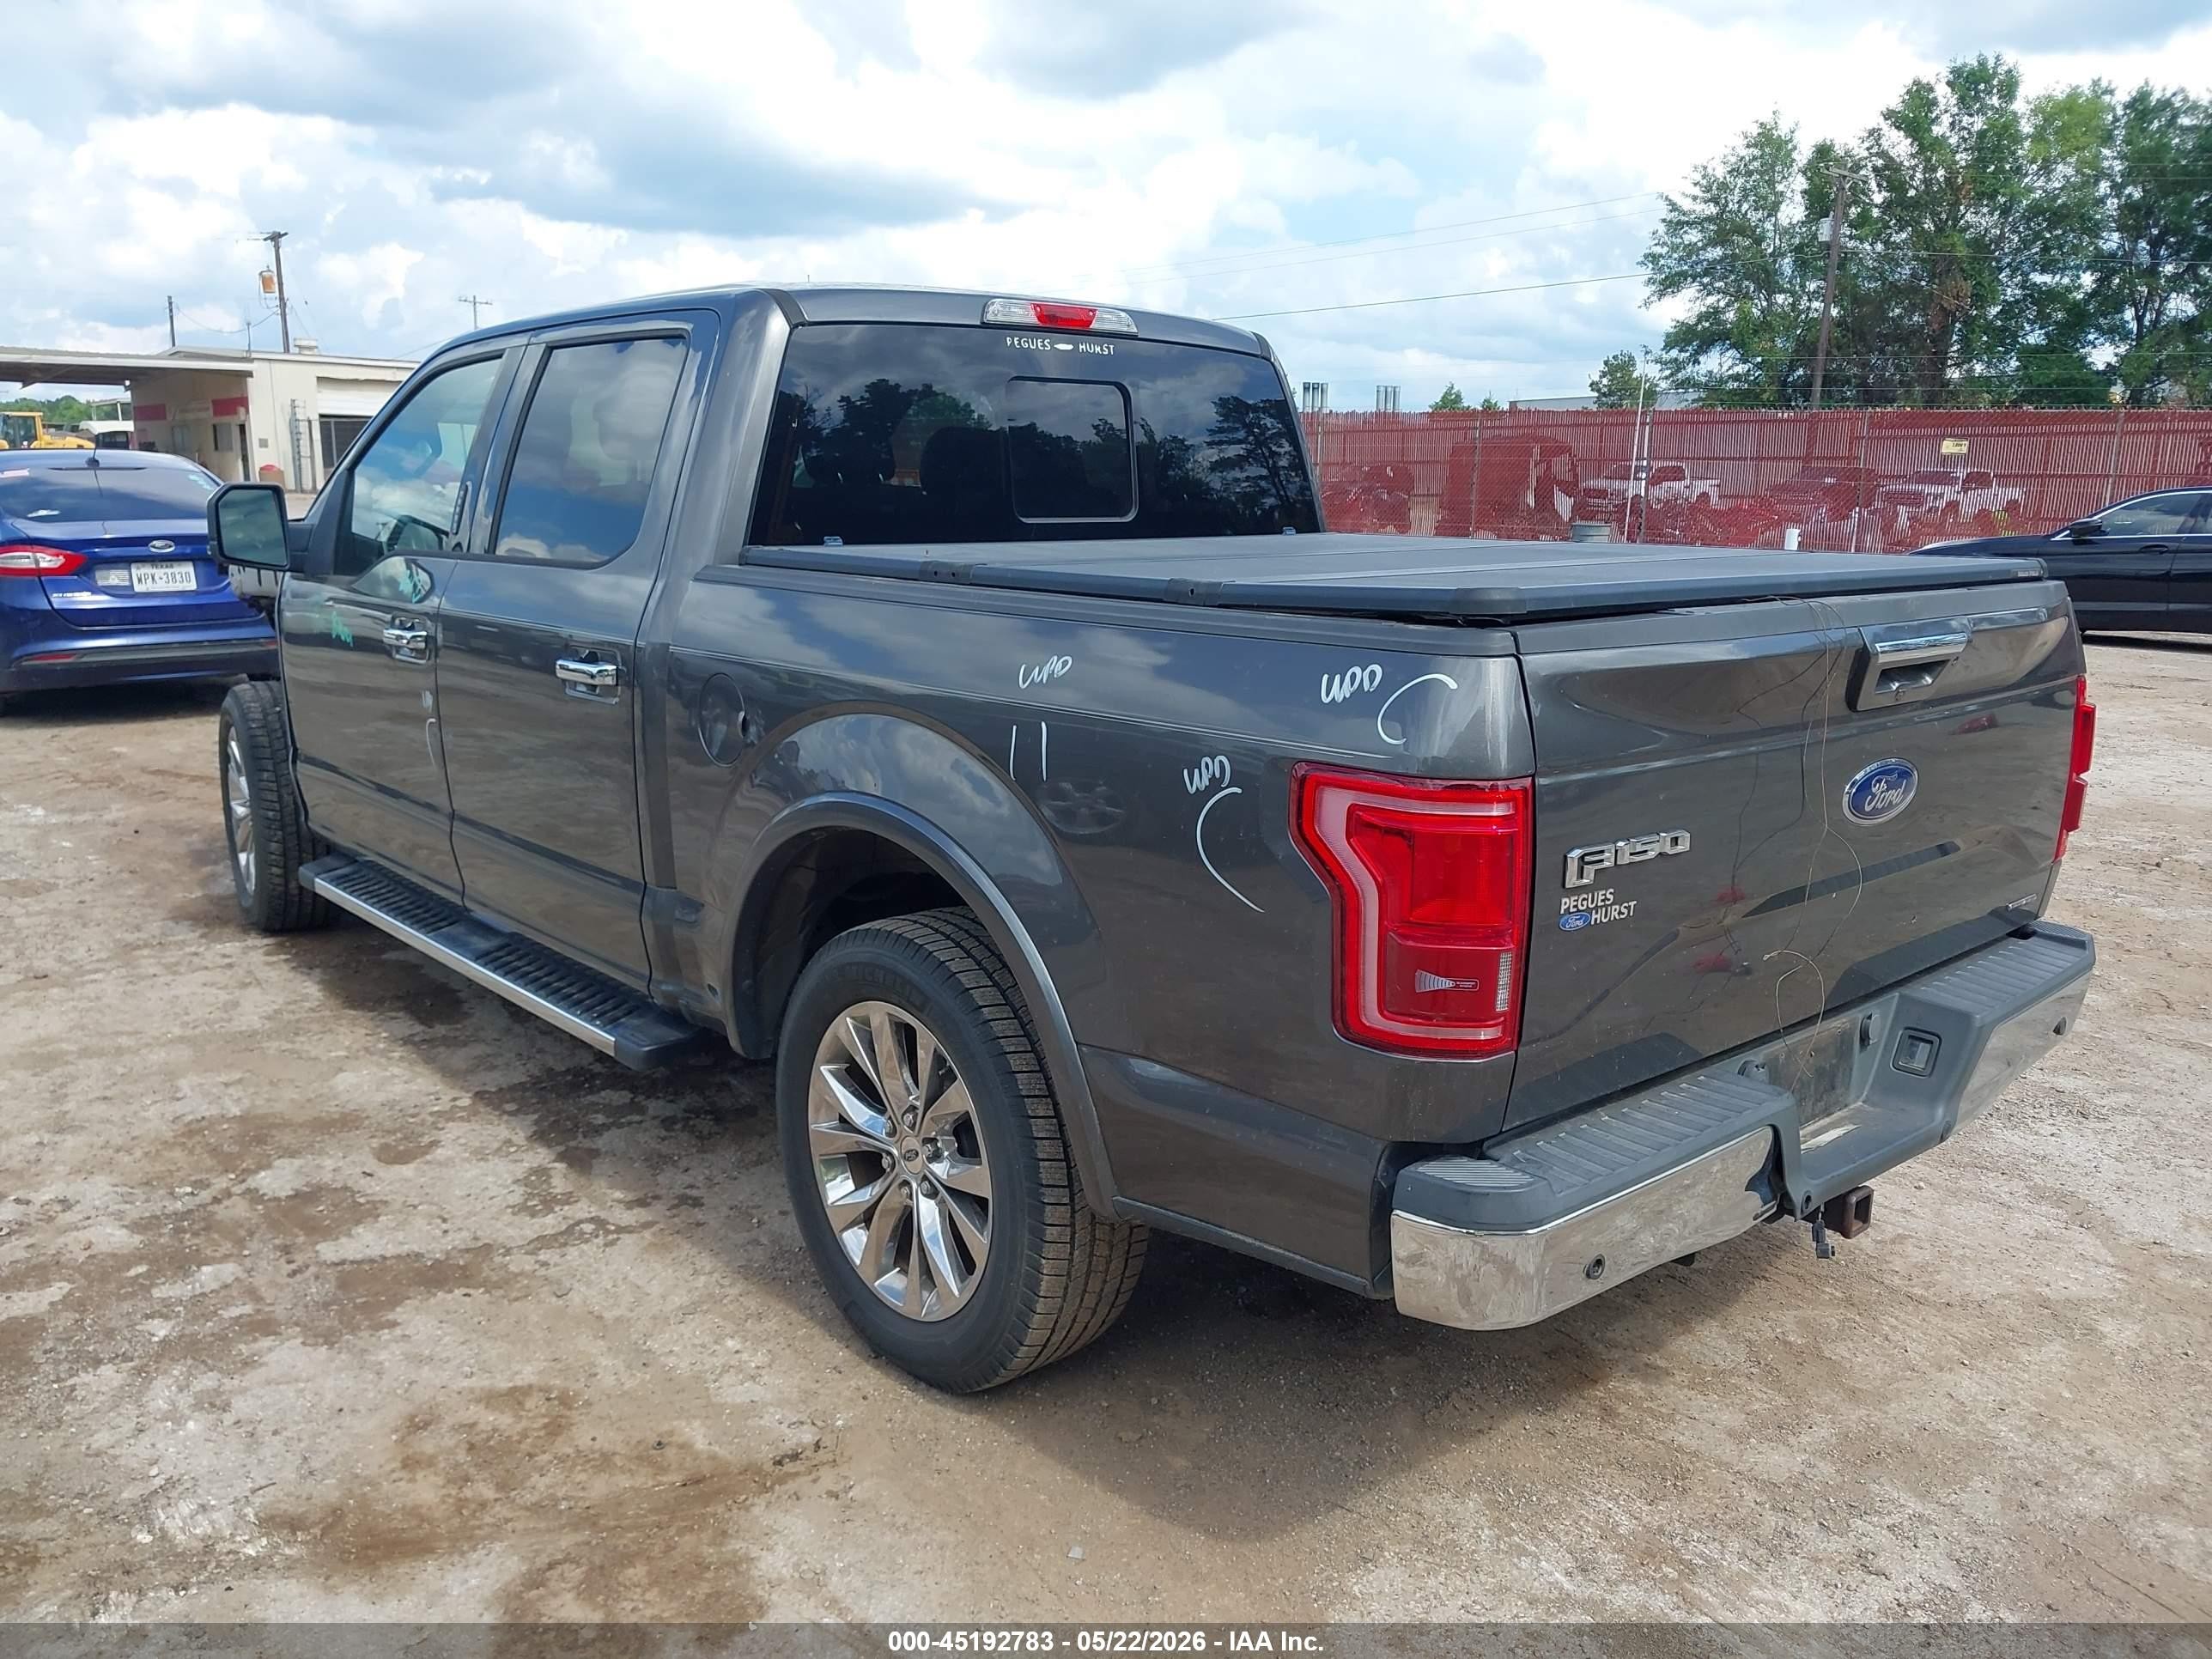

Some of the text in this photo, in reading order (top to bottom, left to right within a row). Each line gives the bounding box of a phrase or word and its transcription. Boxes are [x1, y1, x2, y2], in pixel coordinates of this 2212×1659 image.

[1006, 336, 1115, 356] PEGUES HURST
[1864, 771, 1907, 812] Ford
[1559, 888, 1614, 915] PEGUES
[1590, 901, 1638, 926] HURST
